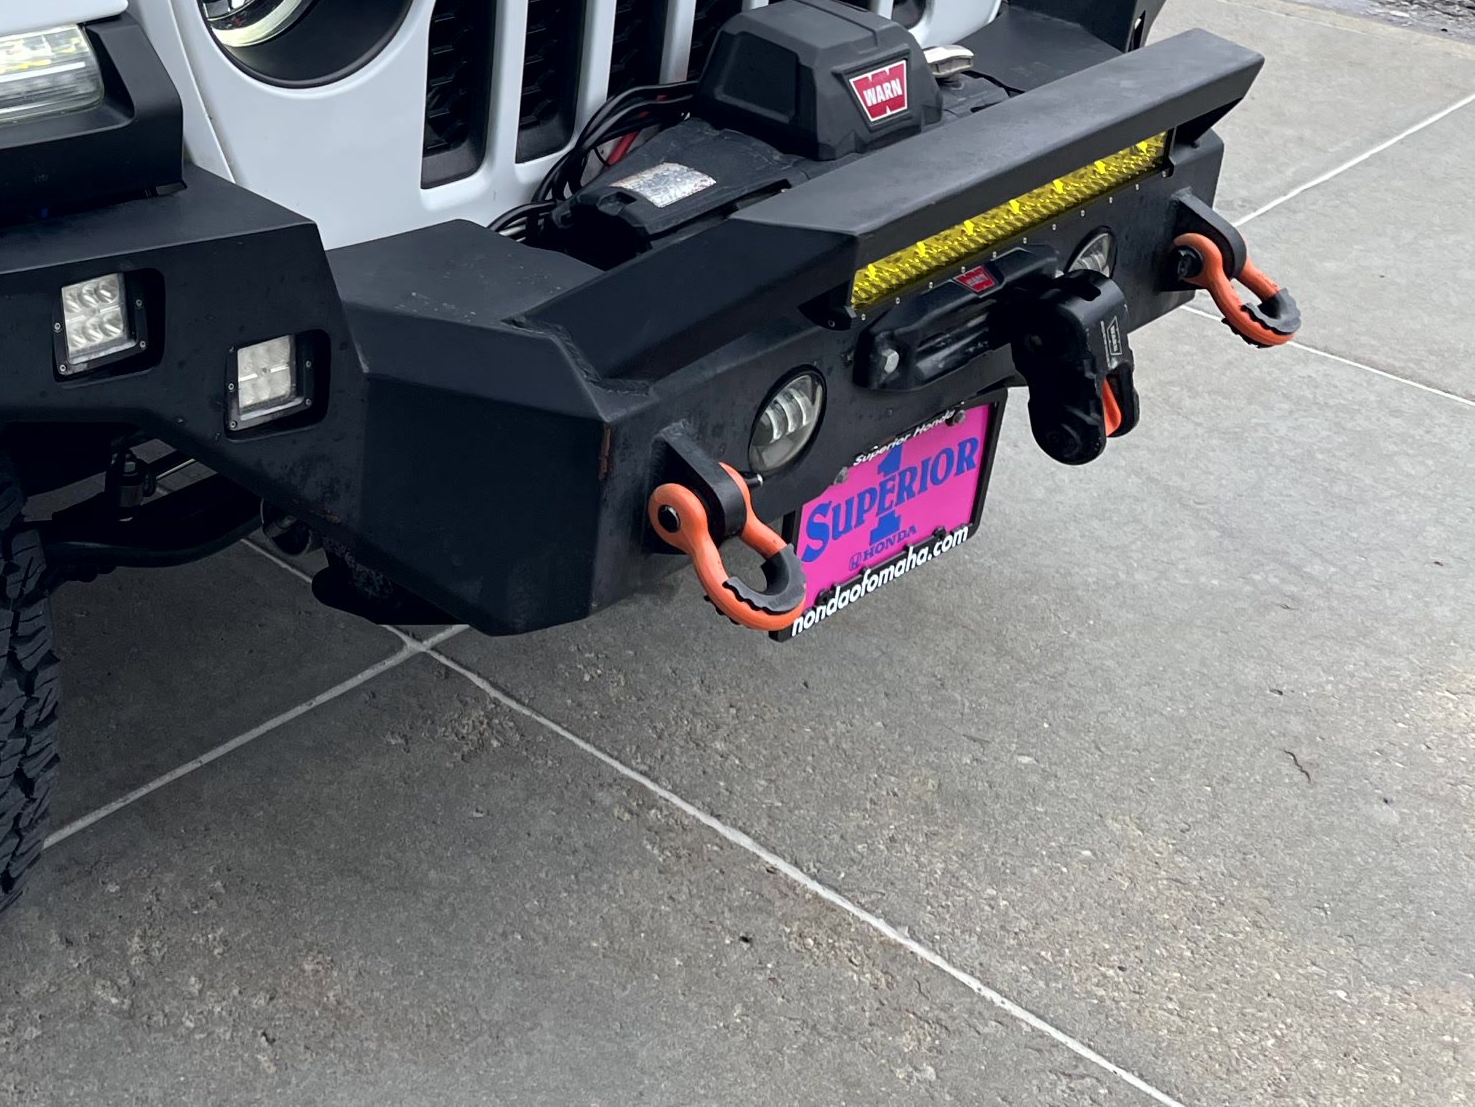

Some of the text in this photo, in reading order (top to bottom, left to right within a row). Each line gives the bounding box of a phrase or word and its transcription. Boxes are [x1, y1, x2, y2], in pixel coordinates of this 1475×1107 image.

[863, 78, 903, 107] WARN
[853, 433, 911, 466] Superior
[801, 437, 980, 563] SUPERIOR
[863, 525, 918, 561] HONDA
